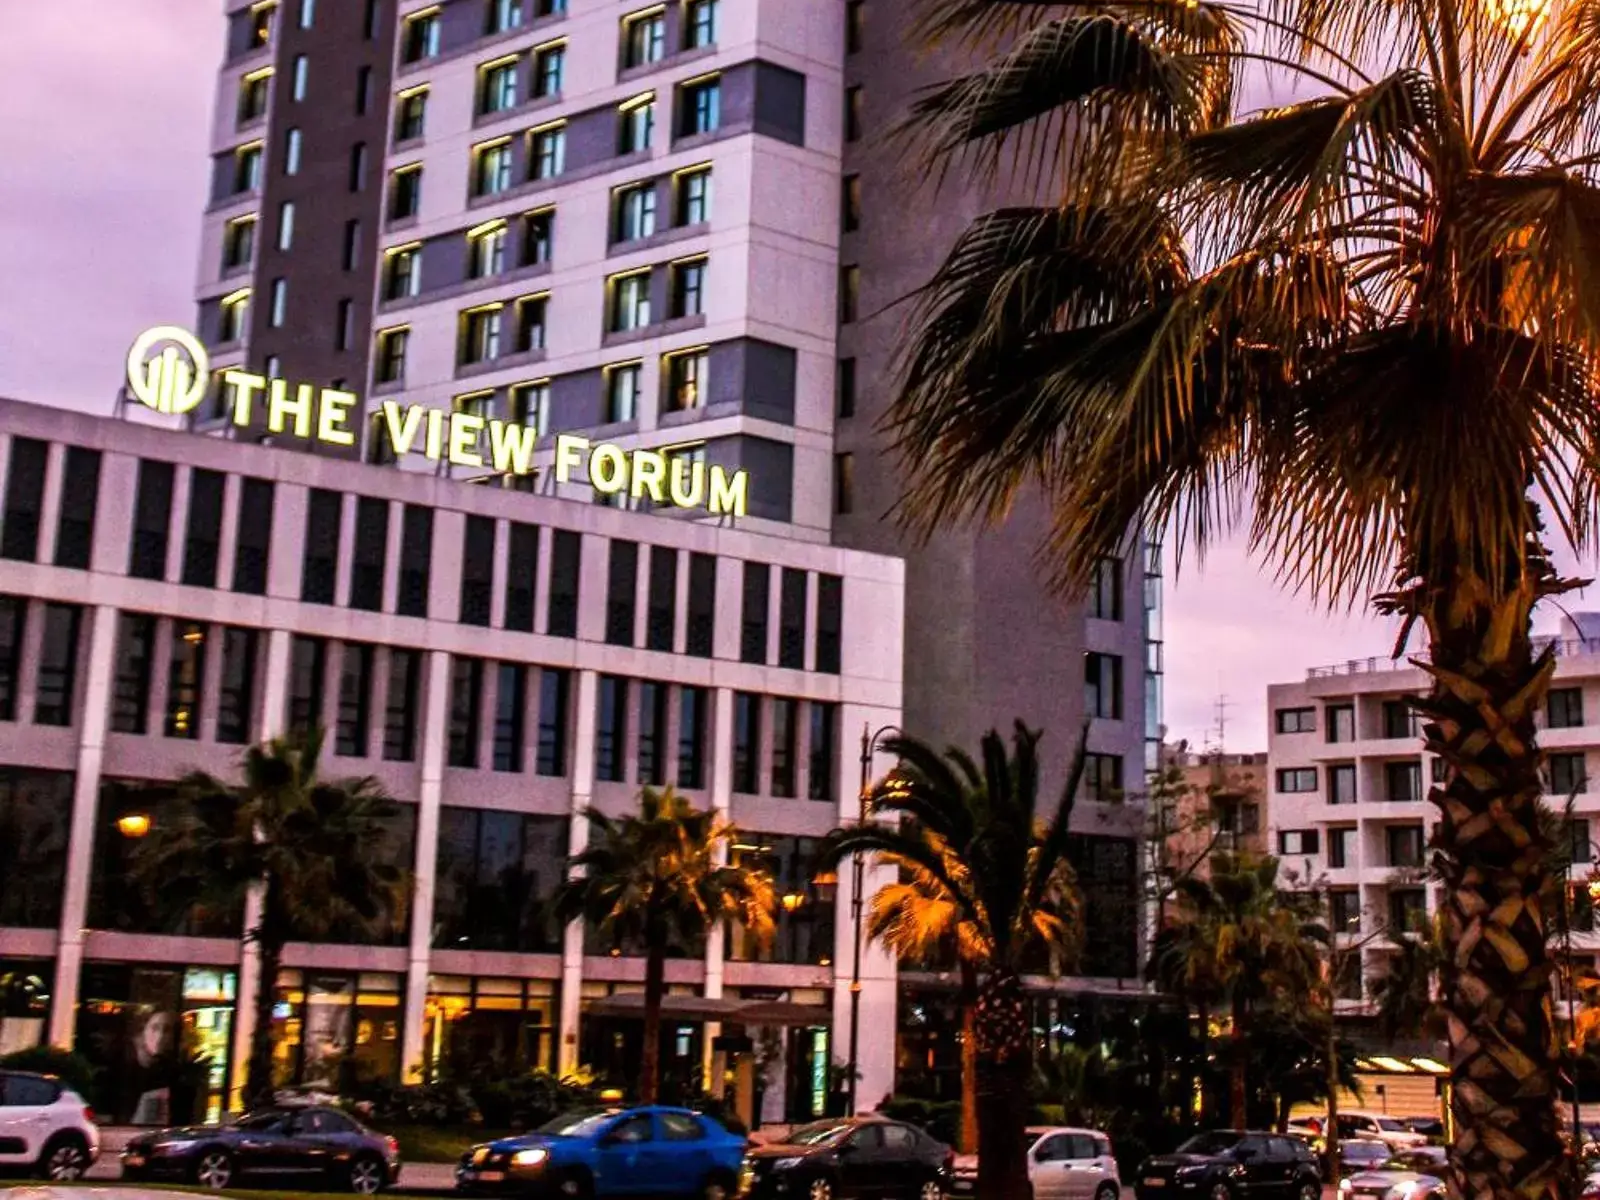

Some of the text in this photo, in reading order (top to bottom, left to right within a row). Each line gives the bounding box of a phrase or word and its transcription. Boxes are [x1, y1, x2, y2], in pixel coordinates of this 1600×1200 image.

[225, 368, 748, 517] THE VIEW FORUM
